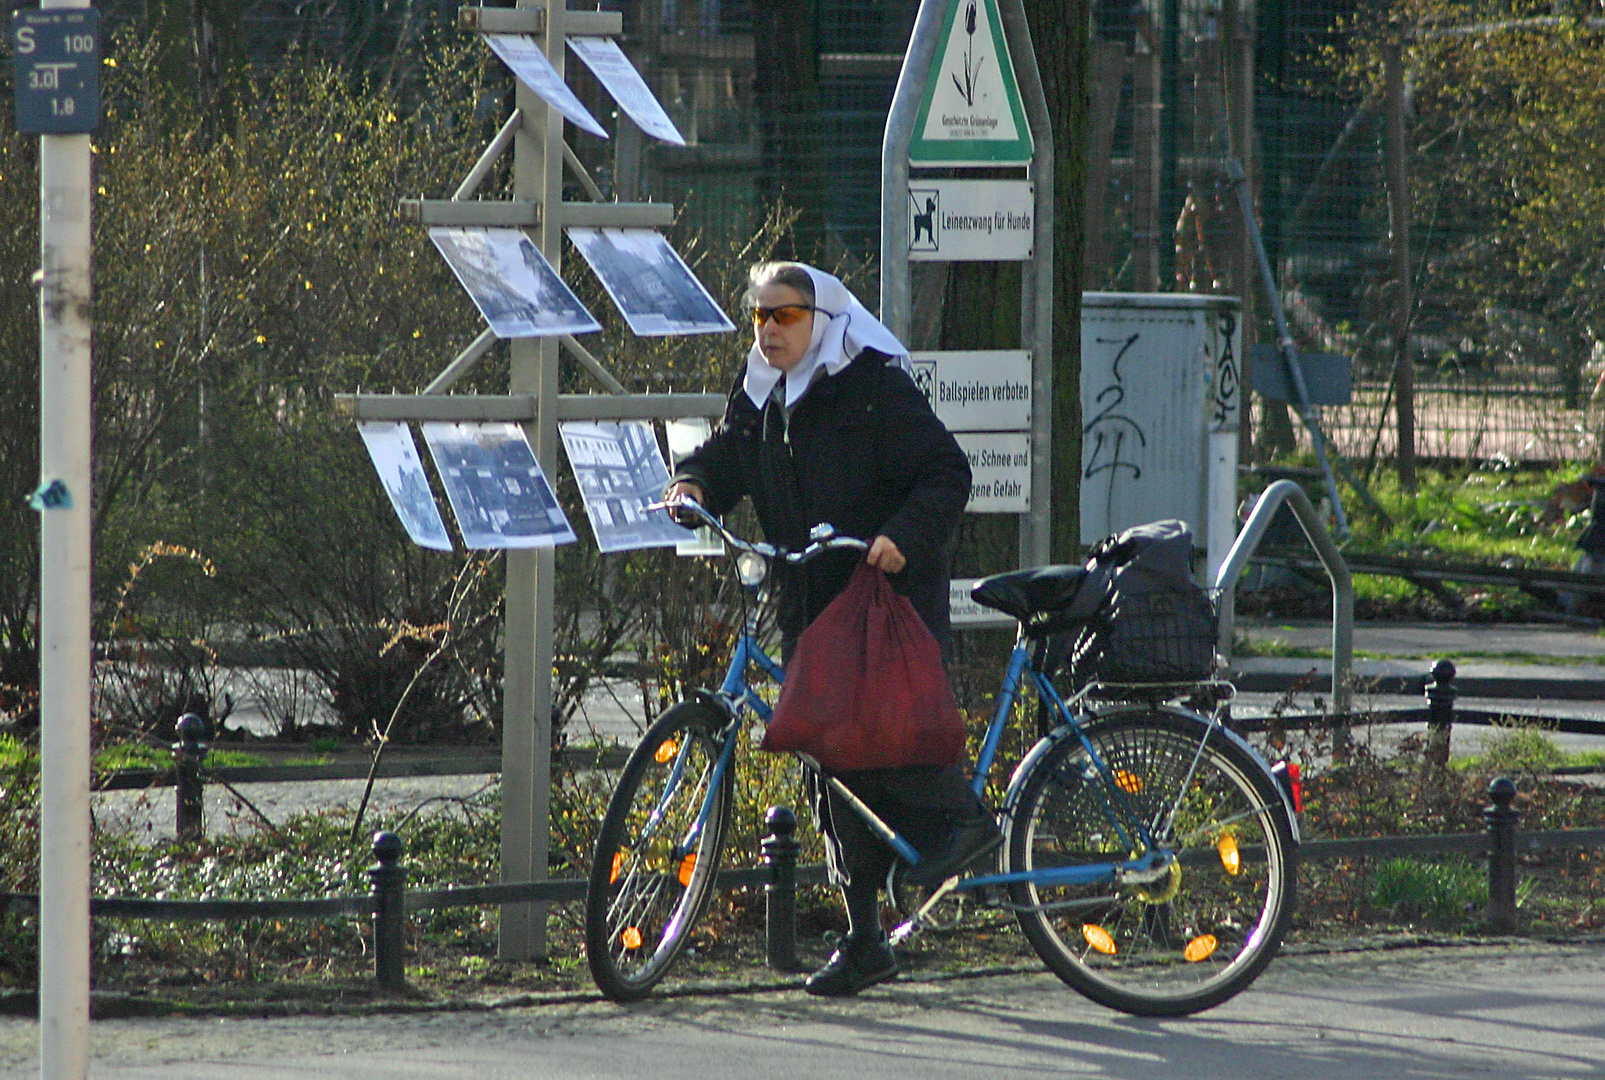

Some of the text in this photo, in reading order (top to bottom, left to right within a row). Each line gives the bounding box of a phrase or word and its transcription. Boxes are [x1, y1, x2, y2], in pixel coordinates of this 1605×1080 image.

[17, 27, 93, 53] S 100
[942, 211, 1030, 235] Leinenzwang für Hunde
[940, 379, 1029, 407] Ballspielen verboten
[981, 449, 1011, 467] Schnee
[1014, 450, 1028, 467] und
[970, 479, 1021, 502] gene Gefahr
